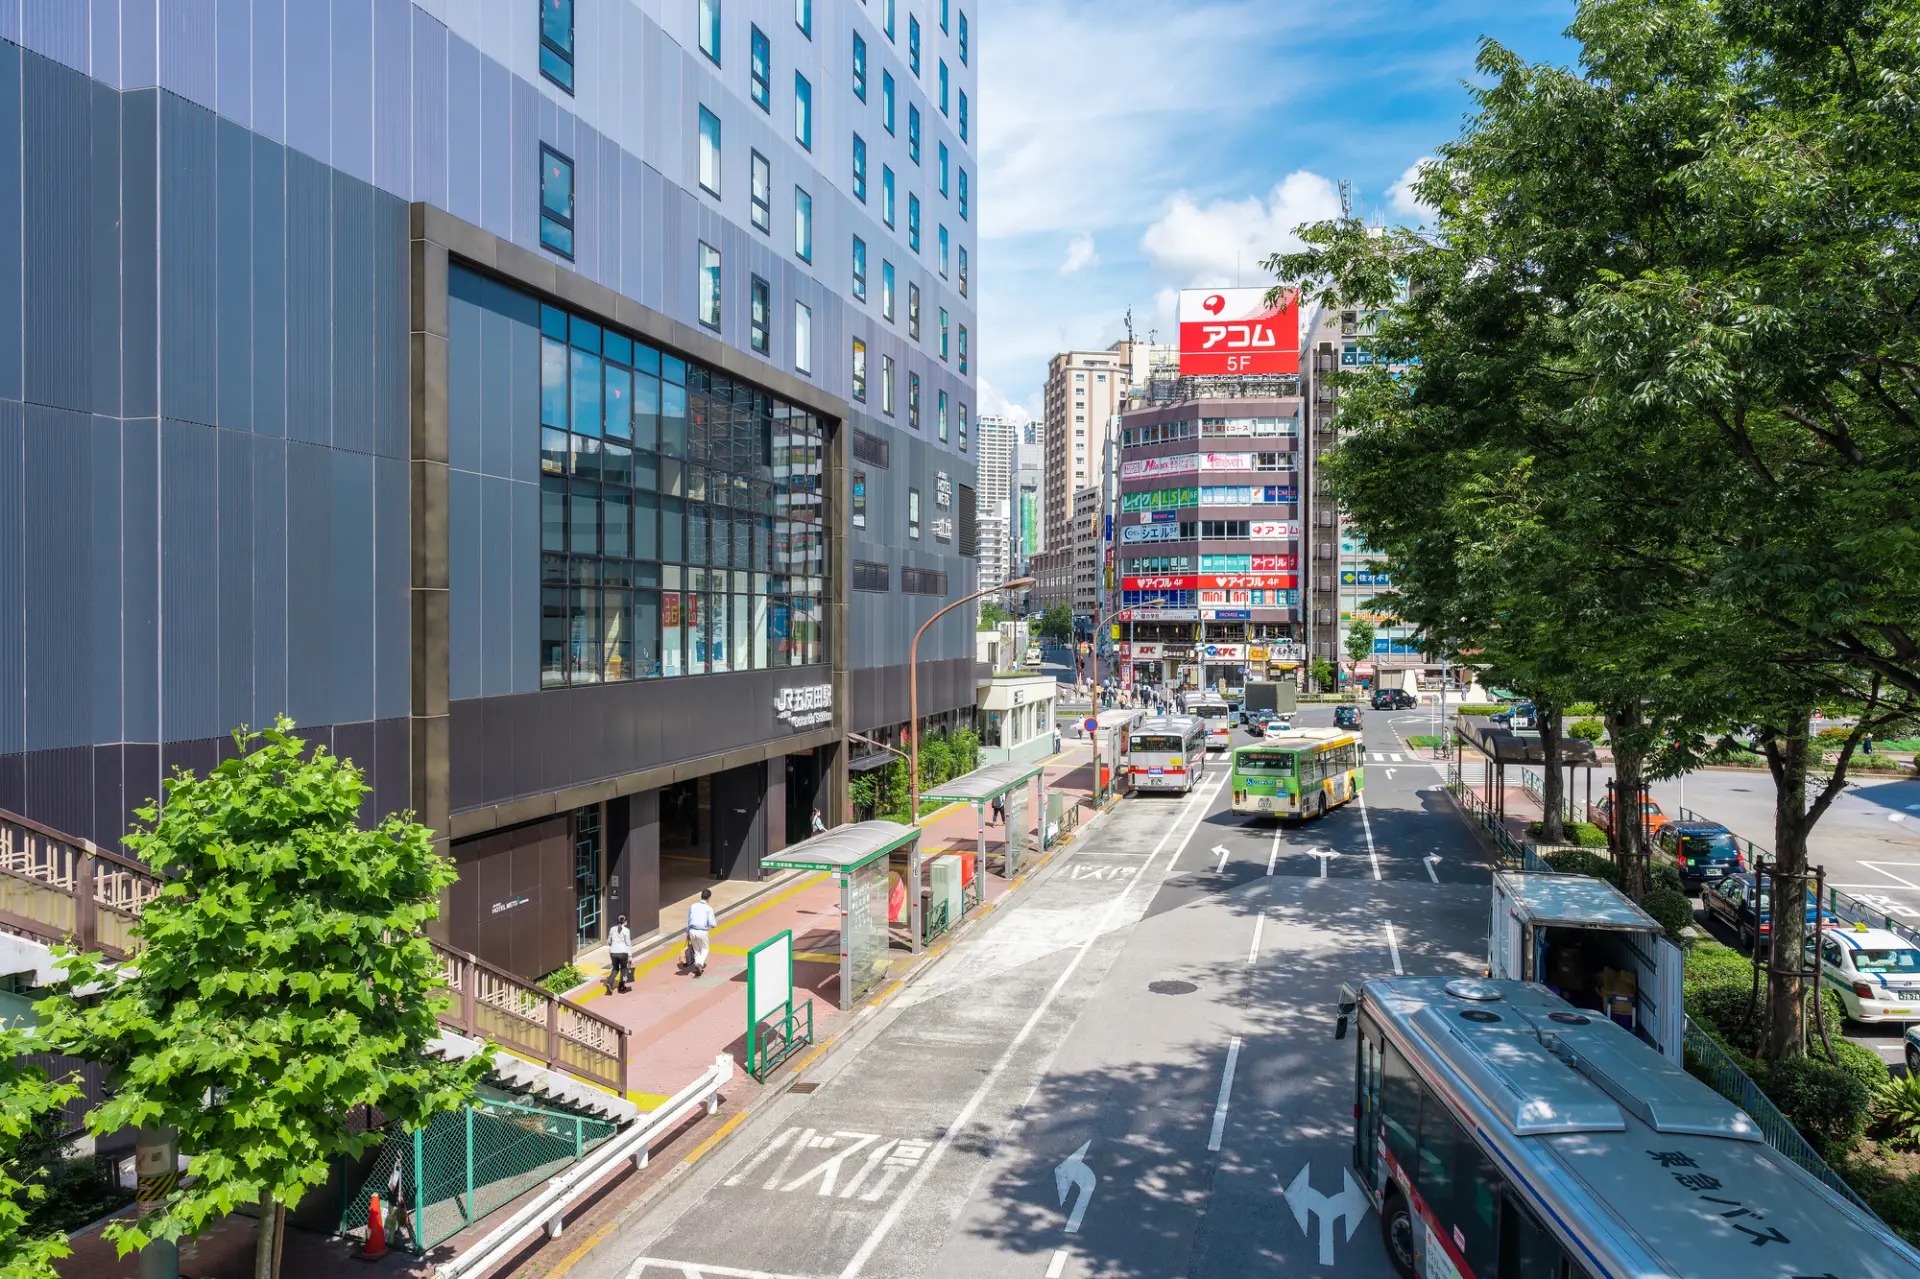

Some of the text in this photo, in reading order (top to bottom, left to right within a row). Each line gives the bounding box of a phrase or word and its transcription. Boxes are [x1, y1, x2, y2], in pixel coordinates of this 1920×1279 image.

[1203, 325, 1276, 349] アコム
[1227, 356, 1251, 371] 5F
[1151, 490, 1188, 504] ALSA
[1142, 527, 1169, 539] シエル
[1265, 526, 1299, 535] アコム
[1252, 558, 1287, 567] アイフル
[1146, 578, 1172, 588] アイフル
[1228, 577, 1264, 587] アイフル
[1202, 592, 1223, 603] mini
[1140, 646, 1156, 654] KFC
[1217, 648, 1237, 656] KFC
[723, 1127, 932, 1201] バス停
[1645, 1150, 1790, 1247] 東急バス
